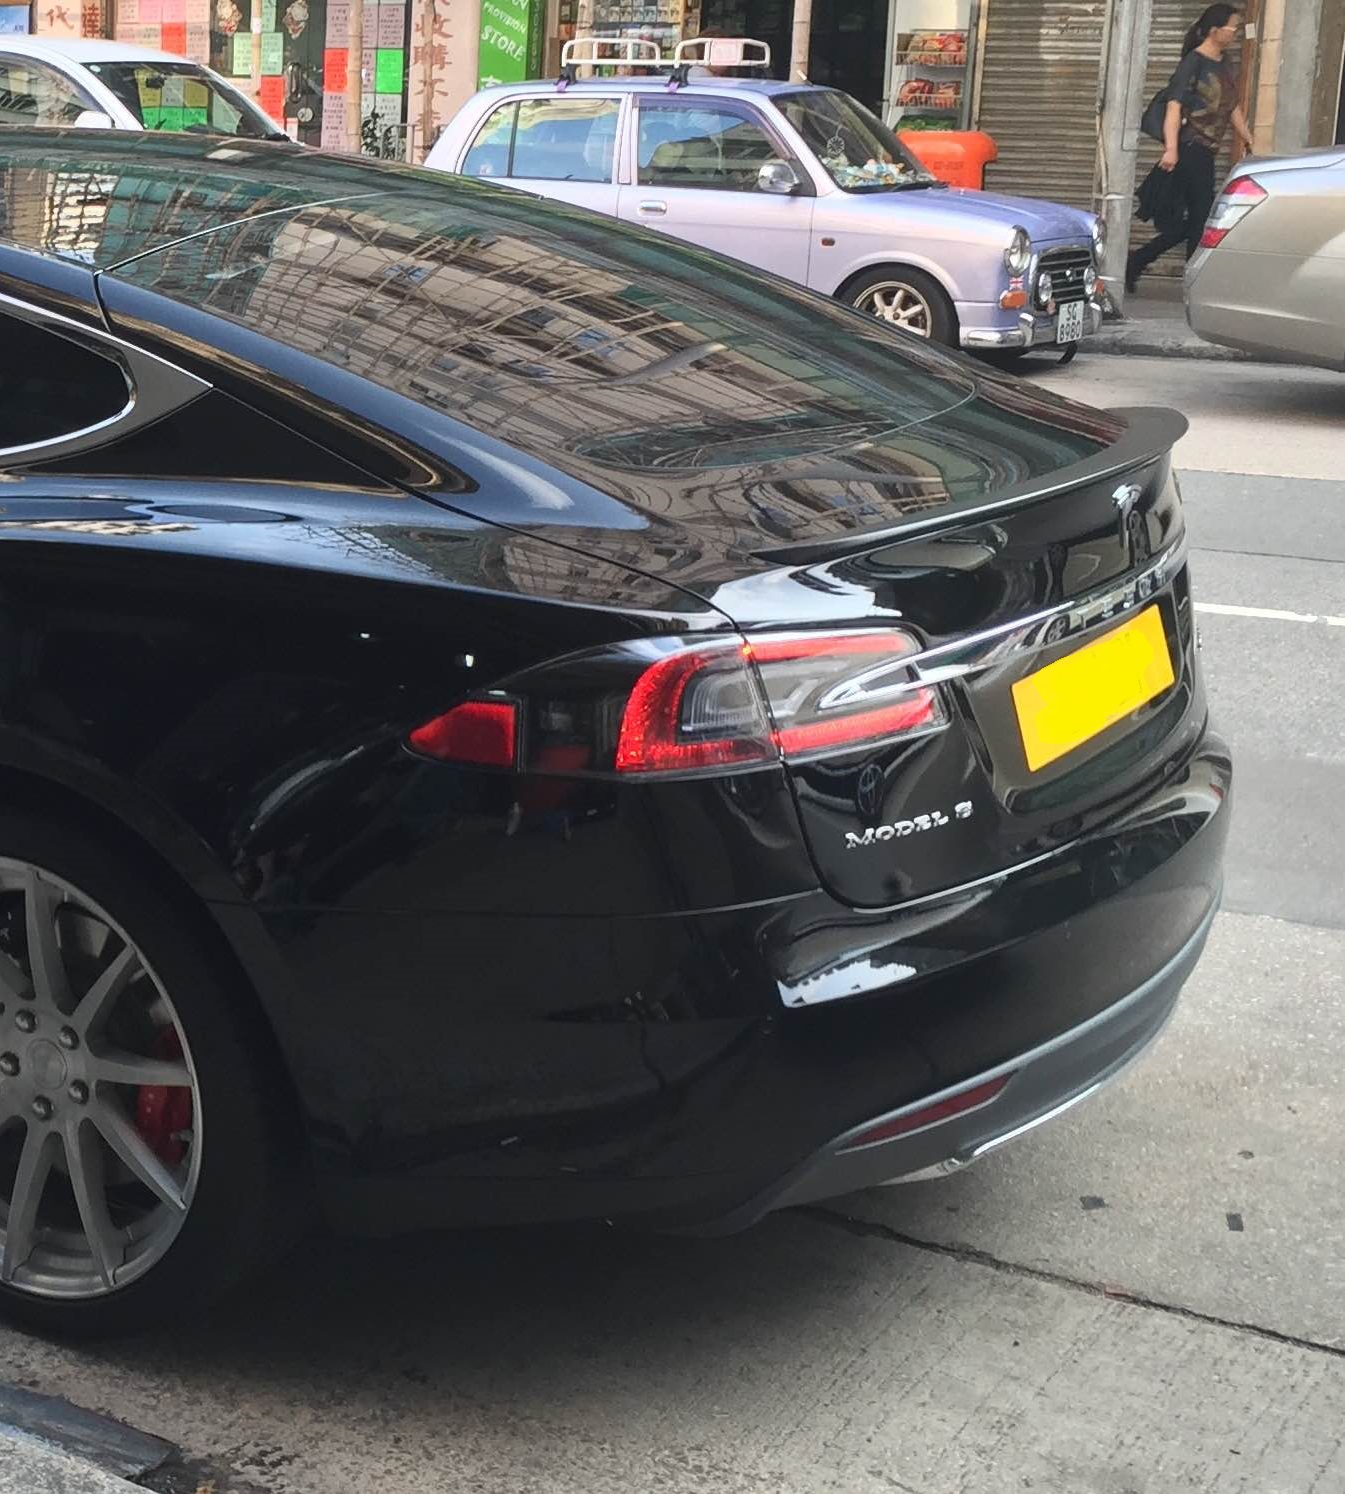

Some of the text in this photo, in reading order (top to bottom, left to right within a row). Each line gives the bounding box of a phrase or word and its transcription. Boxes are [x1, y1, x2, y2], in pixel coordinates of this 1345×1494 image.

[483, 2, 527, 34] PROVISION
[481, 25, 526, 62] STORE
[845, 811, 949, 849] MODEL
